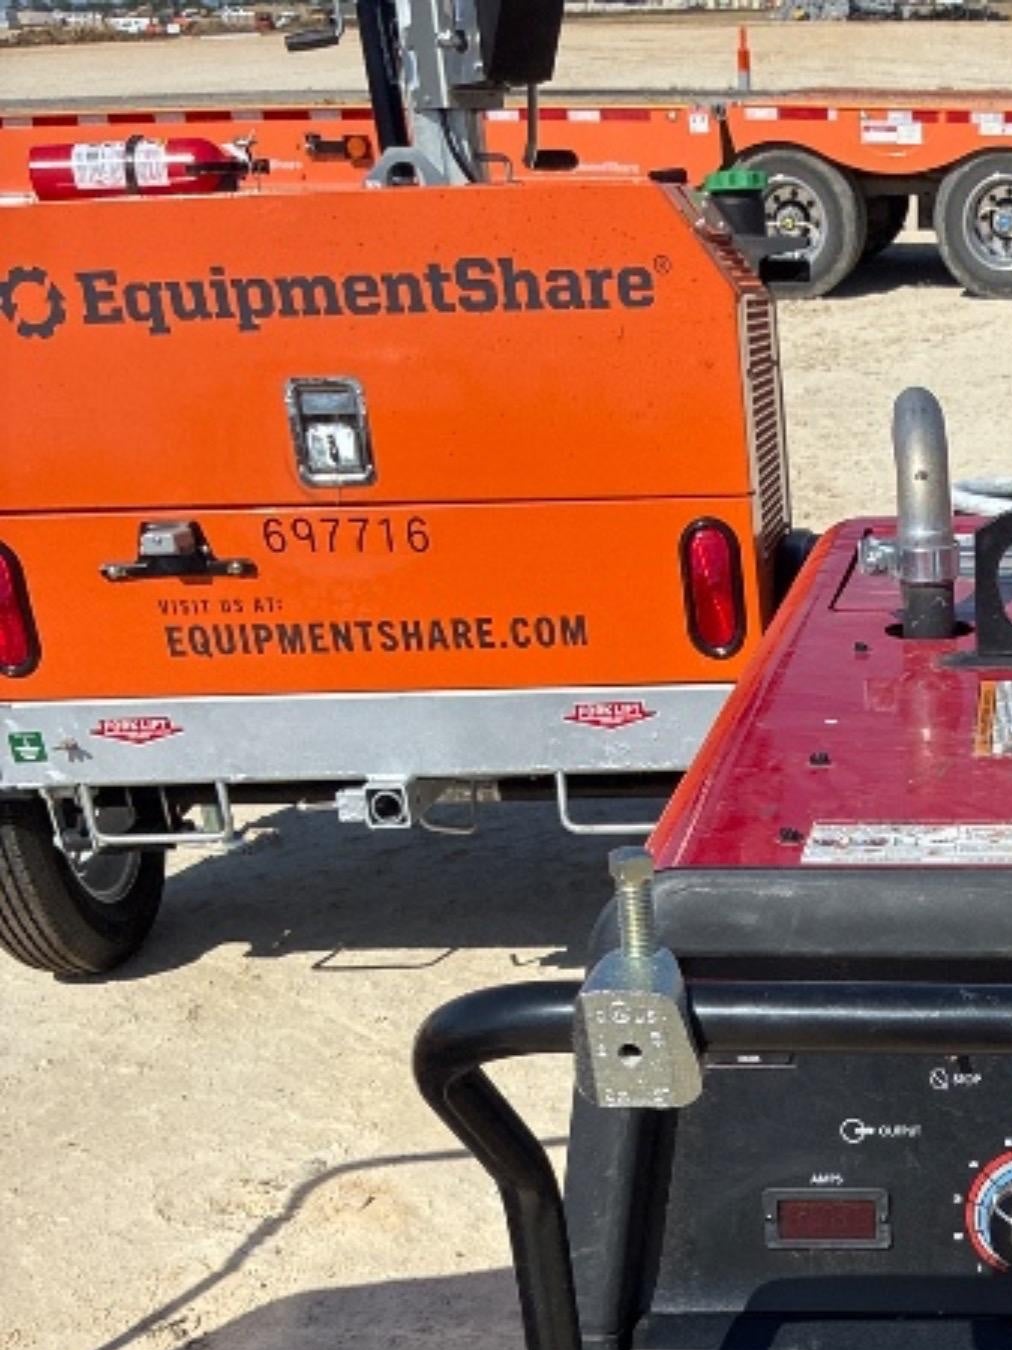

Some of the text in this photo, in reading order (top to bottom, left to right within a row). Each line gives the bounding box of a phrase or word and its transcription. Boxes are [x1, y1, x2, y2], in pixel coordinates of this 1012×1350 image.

[263, 515, 430, 553] 697716
[157, 600, 209, 615] VISIT
[220, 599, 245, 614] US
[164, 614, 589, 660] EQUIPMENTSHARE.COM
